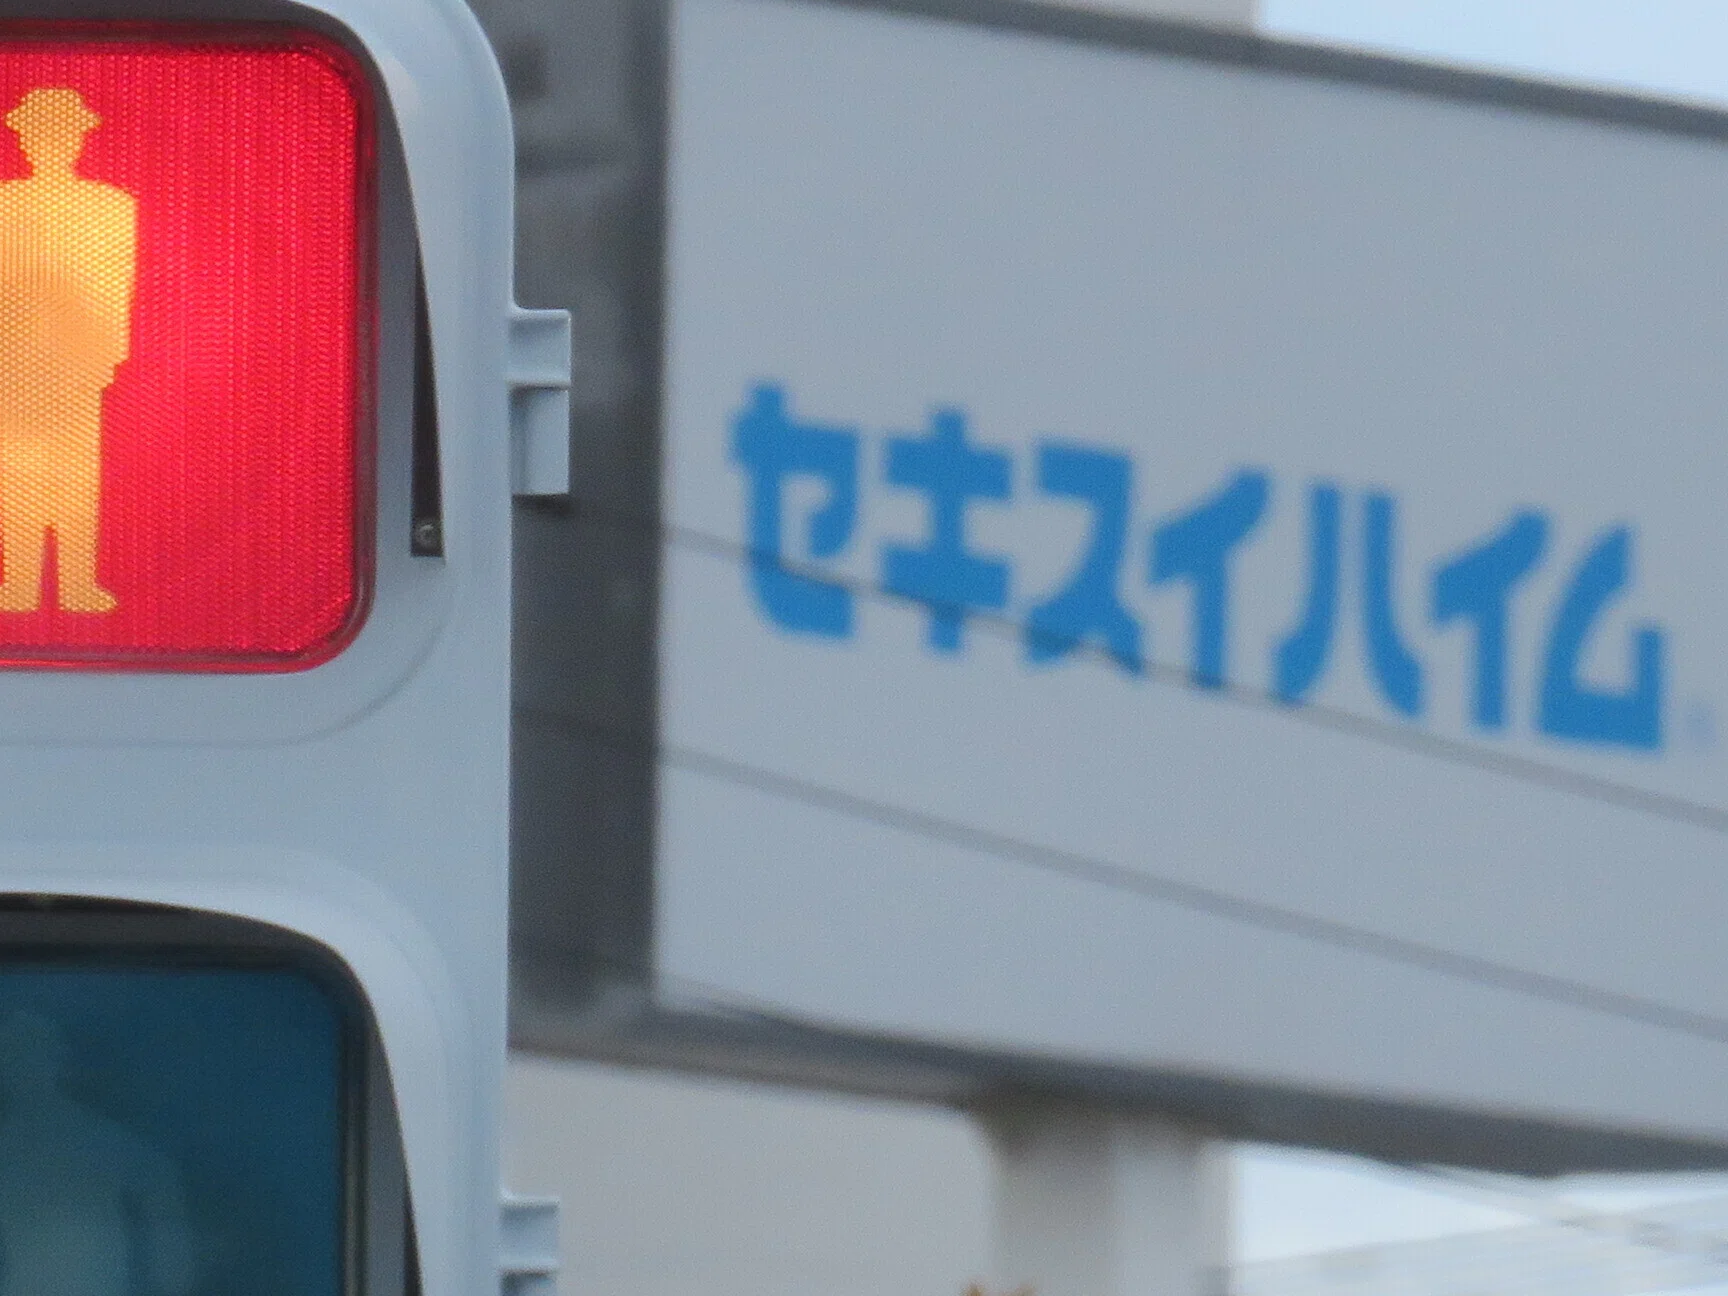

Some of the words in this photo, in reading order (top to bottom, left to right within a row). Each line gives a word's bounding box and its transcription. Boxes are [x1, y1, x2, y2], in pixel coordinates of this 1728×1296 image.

[727, 380, 1668, 754] セキスイハイム
